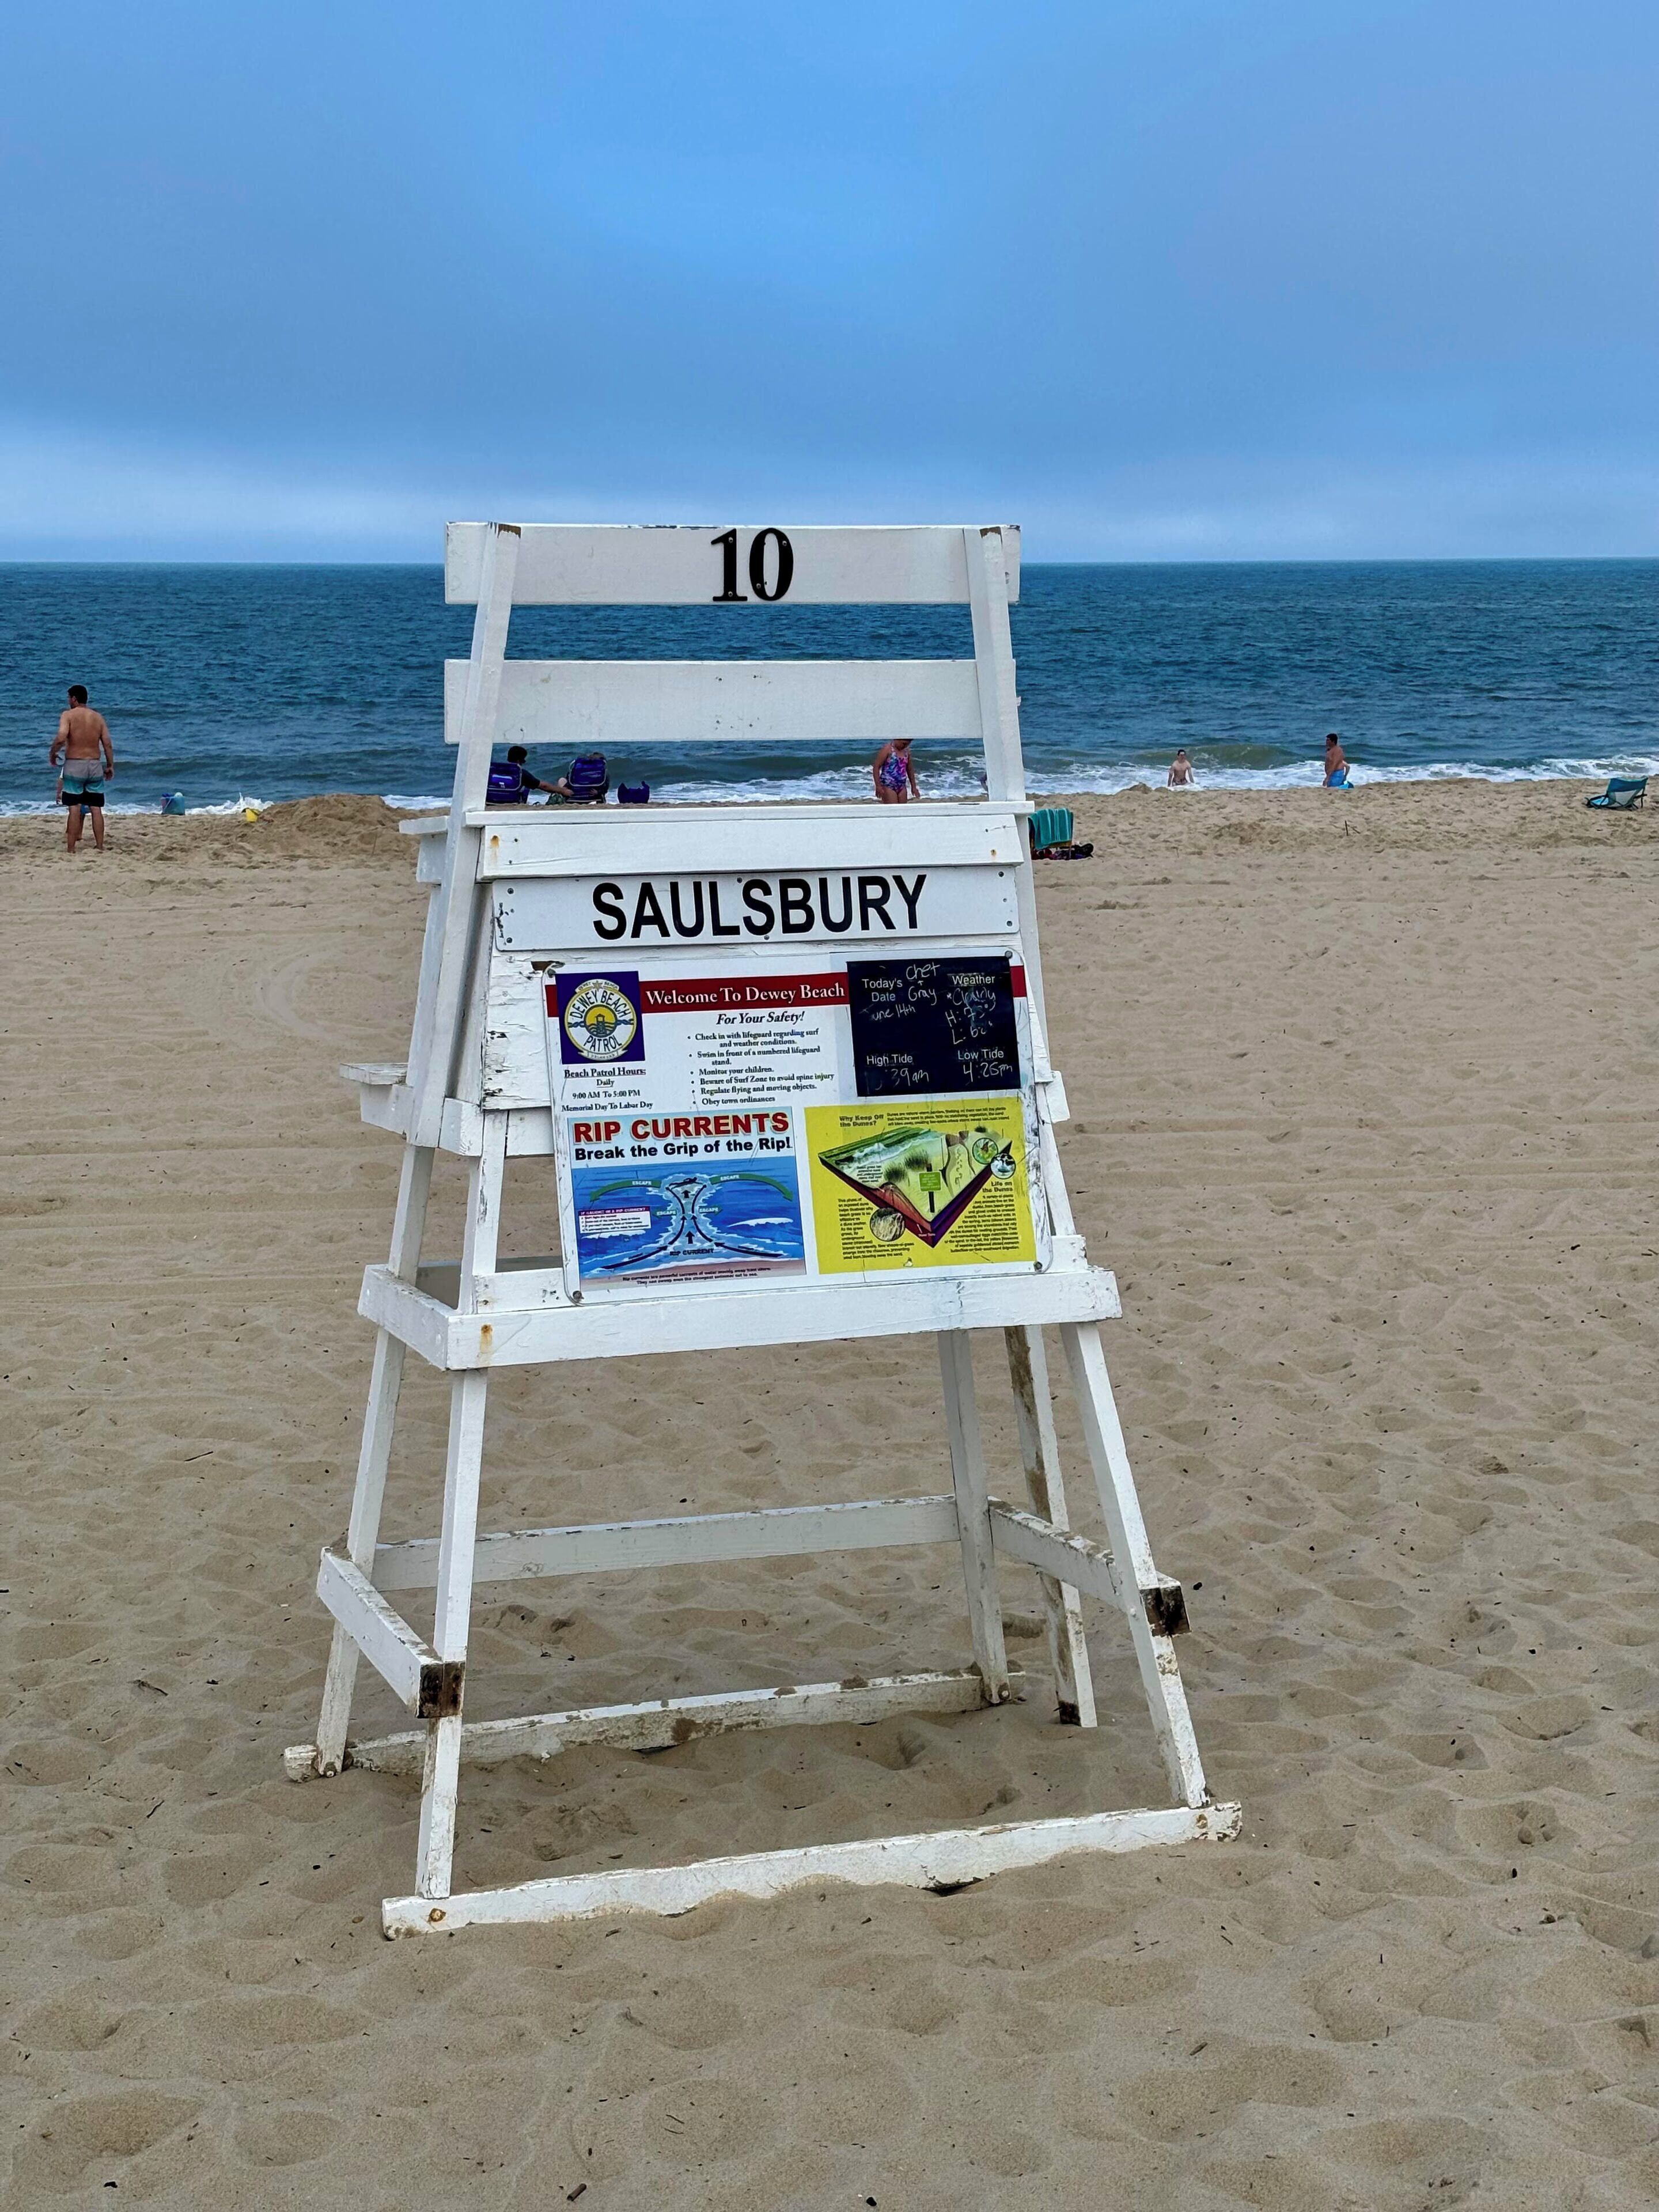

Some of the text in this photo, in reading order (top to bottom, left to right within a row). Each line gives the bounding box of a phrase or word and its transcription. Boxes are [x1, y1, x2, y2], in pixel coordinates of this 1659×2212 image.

[711, 527, 794, 601] 10
[593, 874, 927, 940] SAULSBURY
[862, 979, 903, 990] Today's
[952, 975, 995, 985] Weather
[646, 983, 845, 1005] Welcome To Dewey Beach
[872, 993, 896, 1001] Date
[908, 986, 937, 1005] Gray
[570, 990, 631, 1019] DEWEY BEACH
[716, 1011, 805, 1025] For Your Safety!
[742, 1031, 771, 1040] lifeguard
[773, 1029, 805, 1038] regarding
[583, 1035, 622, 1052] PATROL
[757, 1047, 790, 1055] numbered
[791, 1046, 820, 1055] lifeguard
[958, 1048, 1003, 1059] Low Tide
[866, 1054, 912, 1066] High Tide
[565, 1069, 588, 1078] Beach
[591, 1067, 615, 1077] Patrol
[815, 1072, 834, 1081] injury
[597, 1079, 615, 1087] Daily
[701, 1087, 730, 1096] Regulate
[732, 1086, 751, 1094] flying
[766, 1084, 791, 1092] moving
[792, 1083, 817, 1092] objects.
[640, 1101, 653, 1109] Day
[702, 1098, 720, 1106] Obey
[740, 1096, 775, 1104] ordinances
[573, 1112, 789, 1143] RIP CURRENTS
[575, 1137, 790, 1160] Break the Grip of the Rip!
